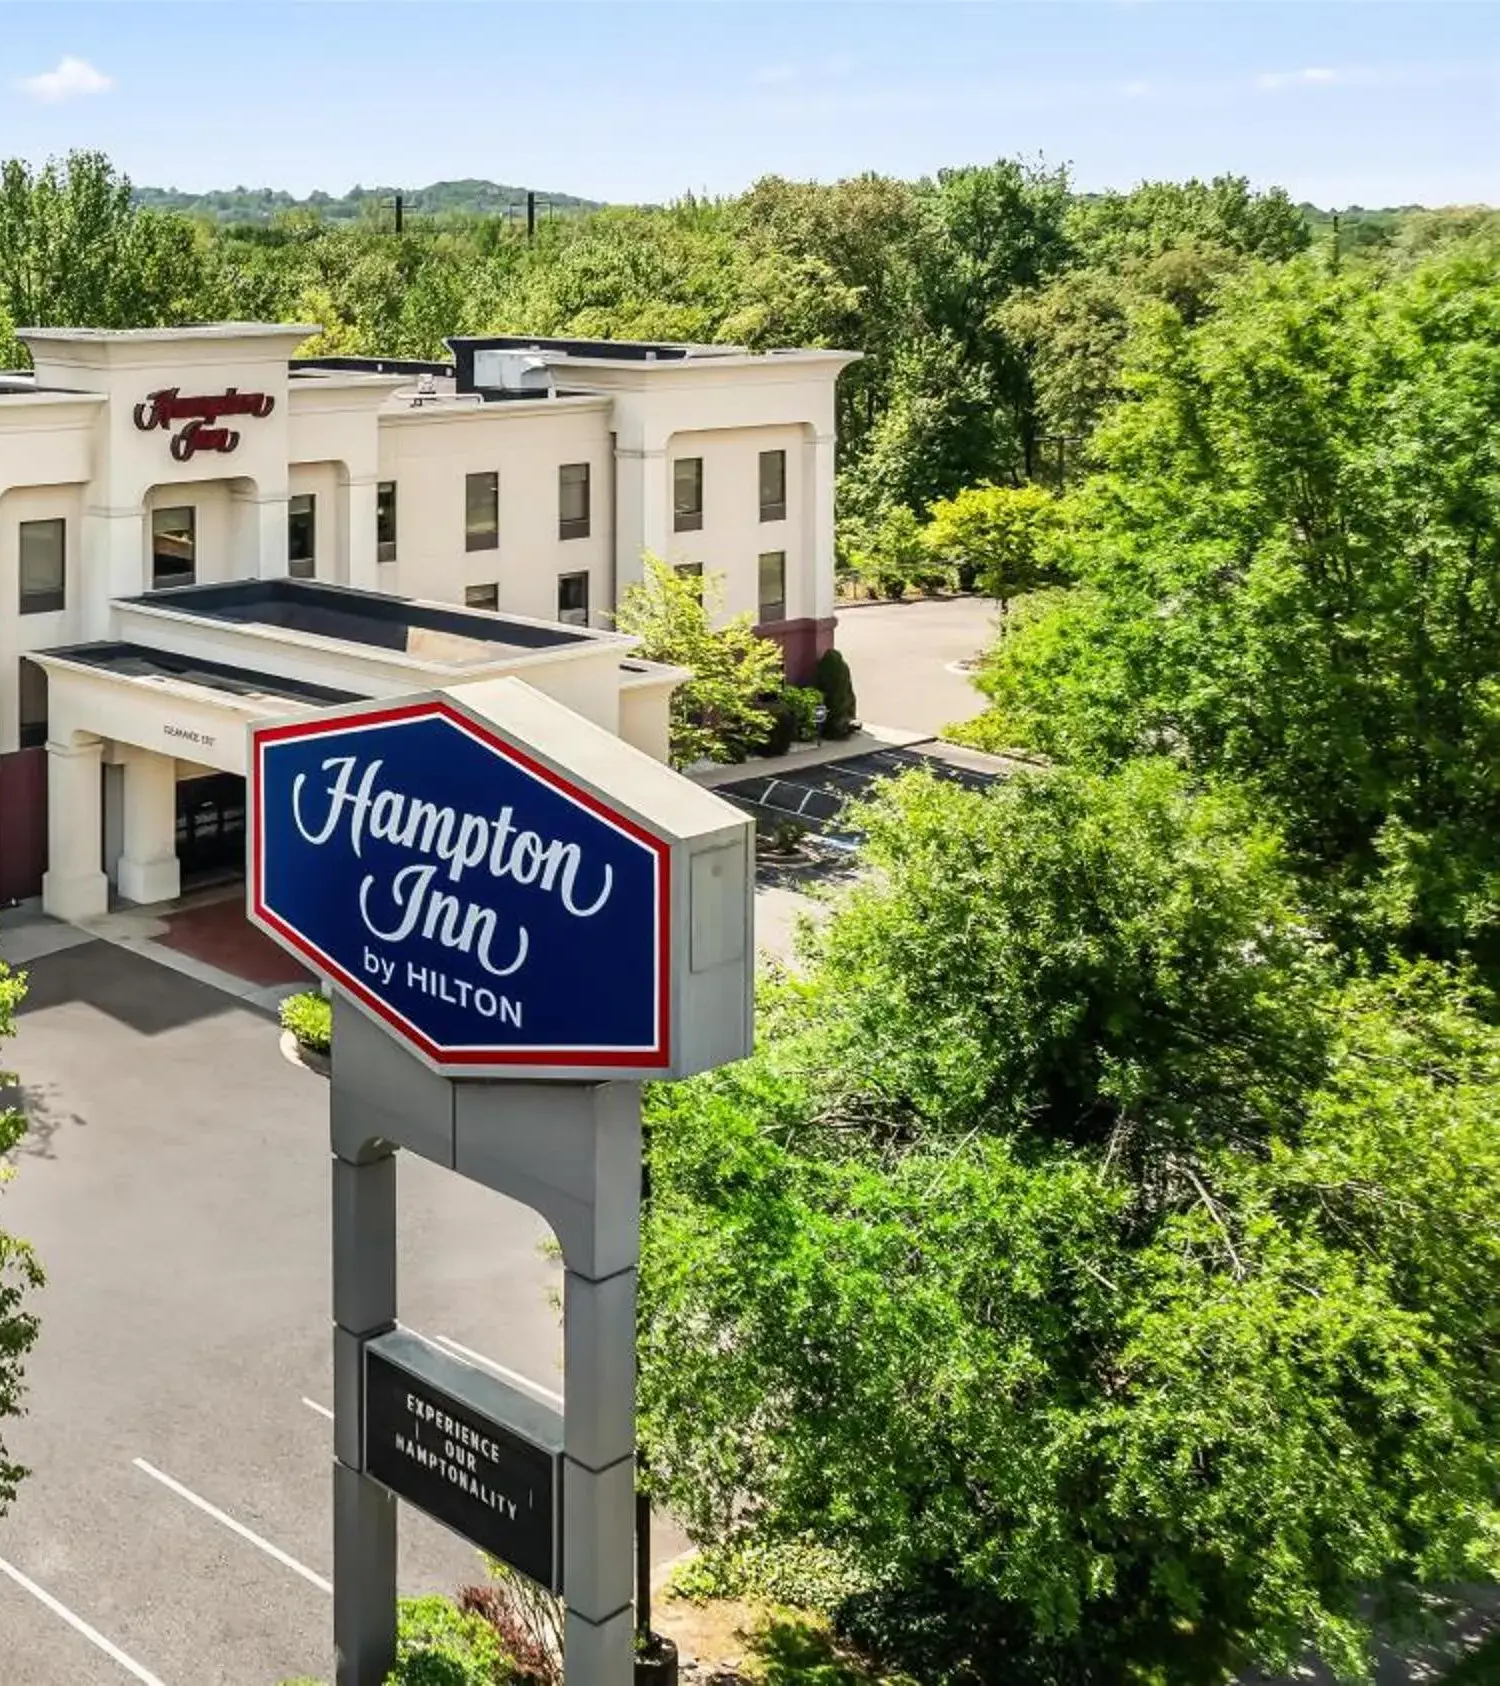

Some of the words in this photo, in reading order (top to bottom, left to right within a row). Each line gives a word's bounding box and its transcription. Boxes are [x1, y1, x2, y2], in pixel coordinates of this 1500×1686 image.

[293, 756, 613, 917] Hampton
[359, 865, 529, 976] Inn
[363, 946, 395, 984] by
[406, 961, 523, 1028] HILTON
[407, 1393, 500, 1463] EXPERIENCE
[445, 1441, 477, 1473] OUR
[395, 1432, 517, 1521] HAMPTONALITY
